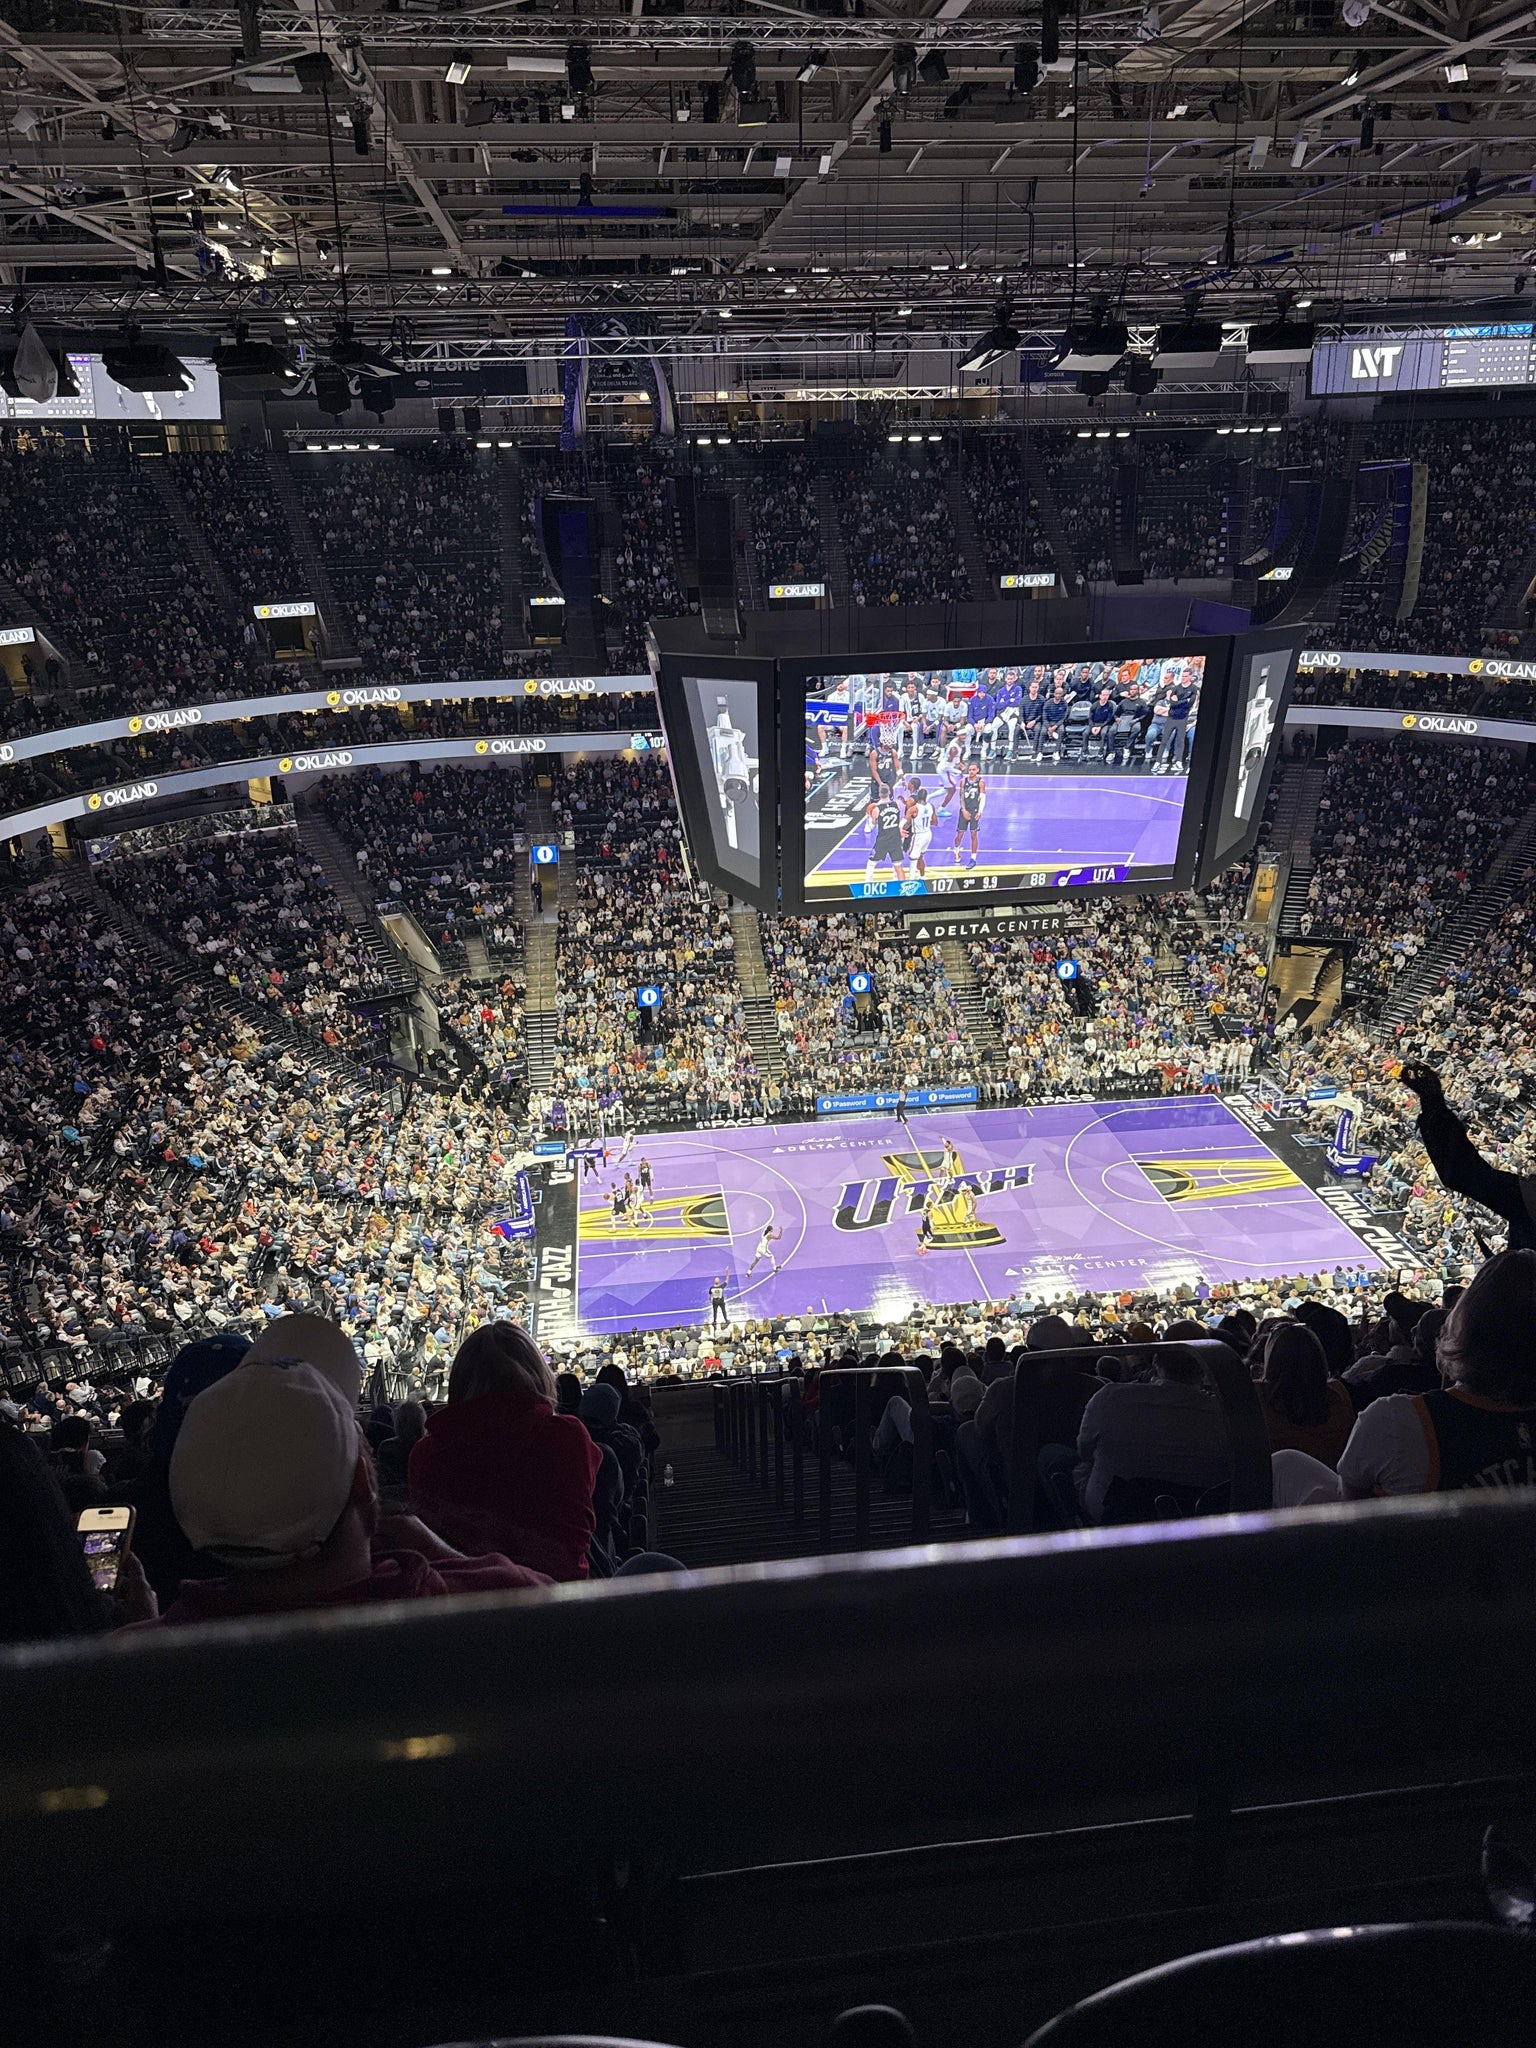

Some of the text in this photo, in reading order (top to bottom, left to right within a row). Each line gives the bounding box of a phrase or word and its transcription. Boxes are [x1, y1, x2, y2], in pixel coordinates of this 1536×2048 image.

[785, 585, 819, 596] OKLAND
[271, 604, 310, 616] OKLAND
[1486, 661, 1536, 678] OKLAN
[540, 679, 595, 694] OKLAND
[343, 687, 401, 705] OKLAND
[145, 709, 202, 730] OKLAND
[1419, 716, 1478, 734] OKLAND
[491, 739, 546, 754] OKLAND
[295, 751, 352, 770] OKLAND
[104, 782, 158, 806] OKLAND
[882, 814, 898, 830] 22
[1030, 873, 1046, 887] 88
[1093, 868, 1116, 881] UTA
[863, 883, 888, 896] OKC
[931, 878, 953, 892] 107
[983, 876, 998, 889] 9.9
[935, 923, 990, 937] DELTA
[997, 918, 1059, 933] CENTER
[938, 1091, 972, 1102] 1Password
[1040, 1093, 1096, 1104] PACS
[831, 1099, 867, 1110] 1Password
[711, 1117, 767, 1129] PACS
[788, 1142, 834, 1153] DELTA
[840, 1138, 893, 1148] CENTER
[832, 1163, 1037, 1233] UTAH
[1315, 1185, 1373, 1220] UTAH
[1022, 1258, 1148, 1276] DELTA CENTER
[536, 1245, 573, 1341] UTAH JAZZ
